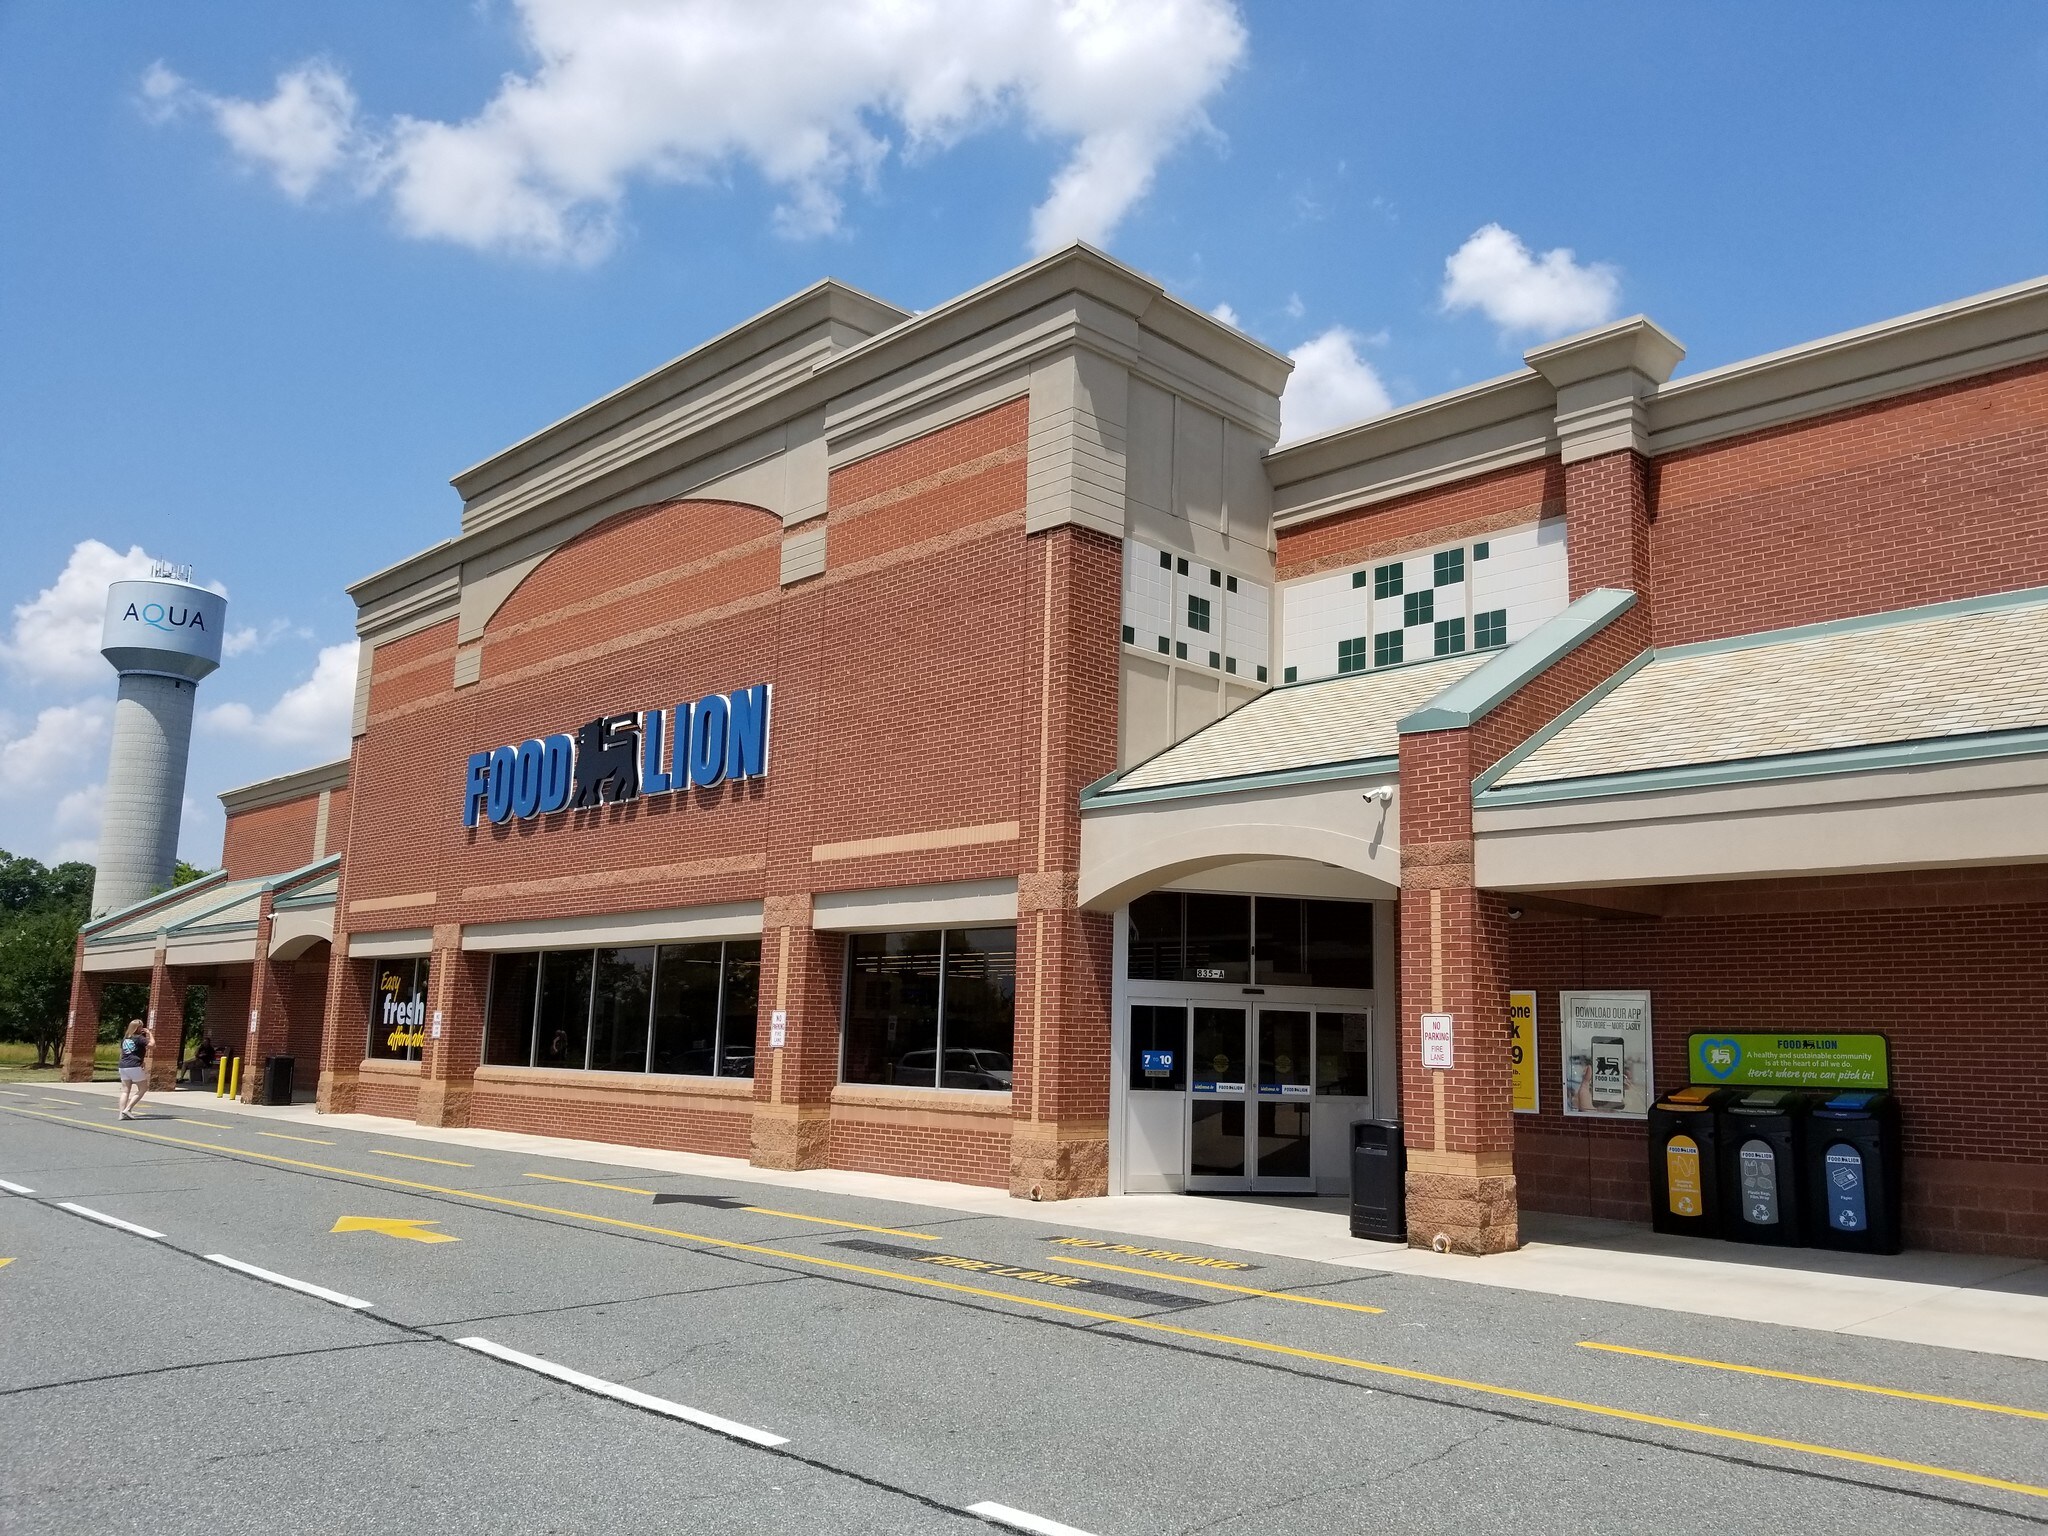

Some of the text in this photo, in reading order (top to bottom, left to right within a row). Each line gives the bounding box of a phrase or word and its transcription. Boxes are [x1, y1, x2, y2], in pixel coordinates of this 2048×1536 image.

[123, 603, 205, 631] AQUA
[463, 684, 772, 828] FOOD LION
[1197, 969, 1224, 978] 835-A
[381, 971, 401, 1002] Easy
[383, 993, 425, 1025] fresh
[1511, 1006, 1530, 1018] one
[1576, 1006, 1641, 1019] DOWNLOAD OUR APP
[1432, 1021, 1441, 1030] NO
[1576, 1020, 1582, 1028] TO
[1582, 1021, 1593, 1029] SAVE
[1594, 1021, 1606, 1029] MORE
[1612, 1022, 1625, 1030] MORE
[1425, 1032, 1450, 1041] PARKING
[1778, 1040, 1837, 1049] FOOD LION
[1144, 1055, 1151, 1064] 7
[1160, 1055, 1172, 1065] 10
[1753, 1052, 1777, 1060] healthy
[1748, 1068, 1875, 1083] Here's where you can pitch in!
[1100, 1245, 1249, 1270] PARKING
[988, 1267, 1092, 1287] LANE
